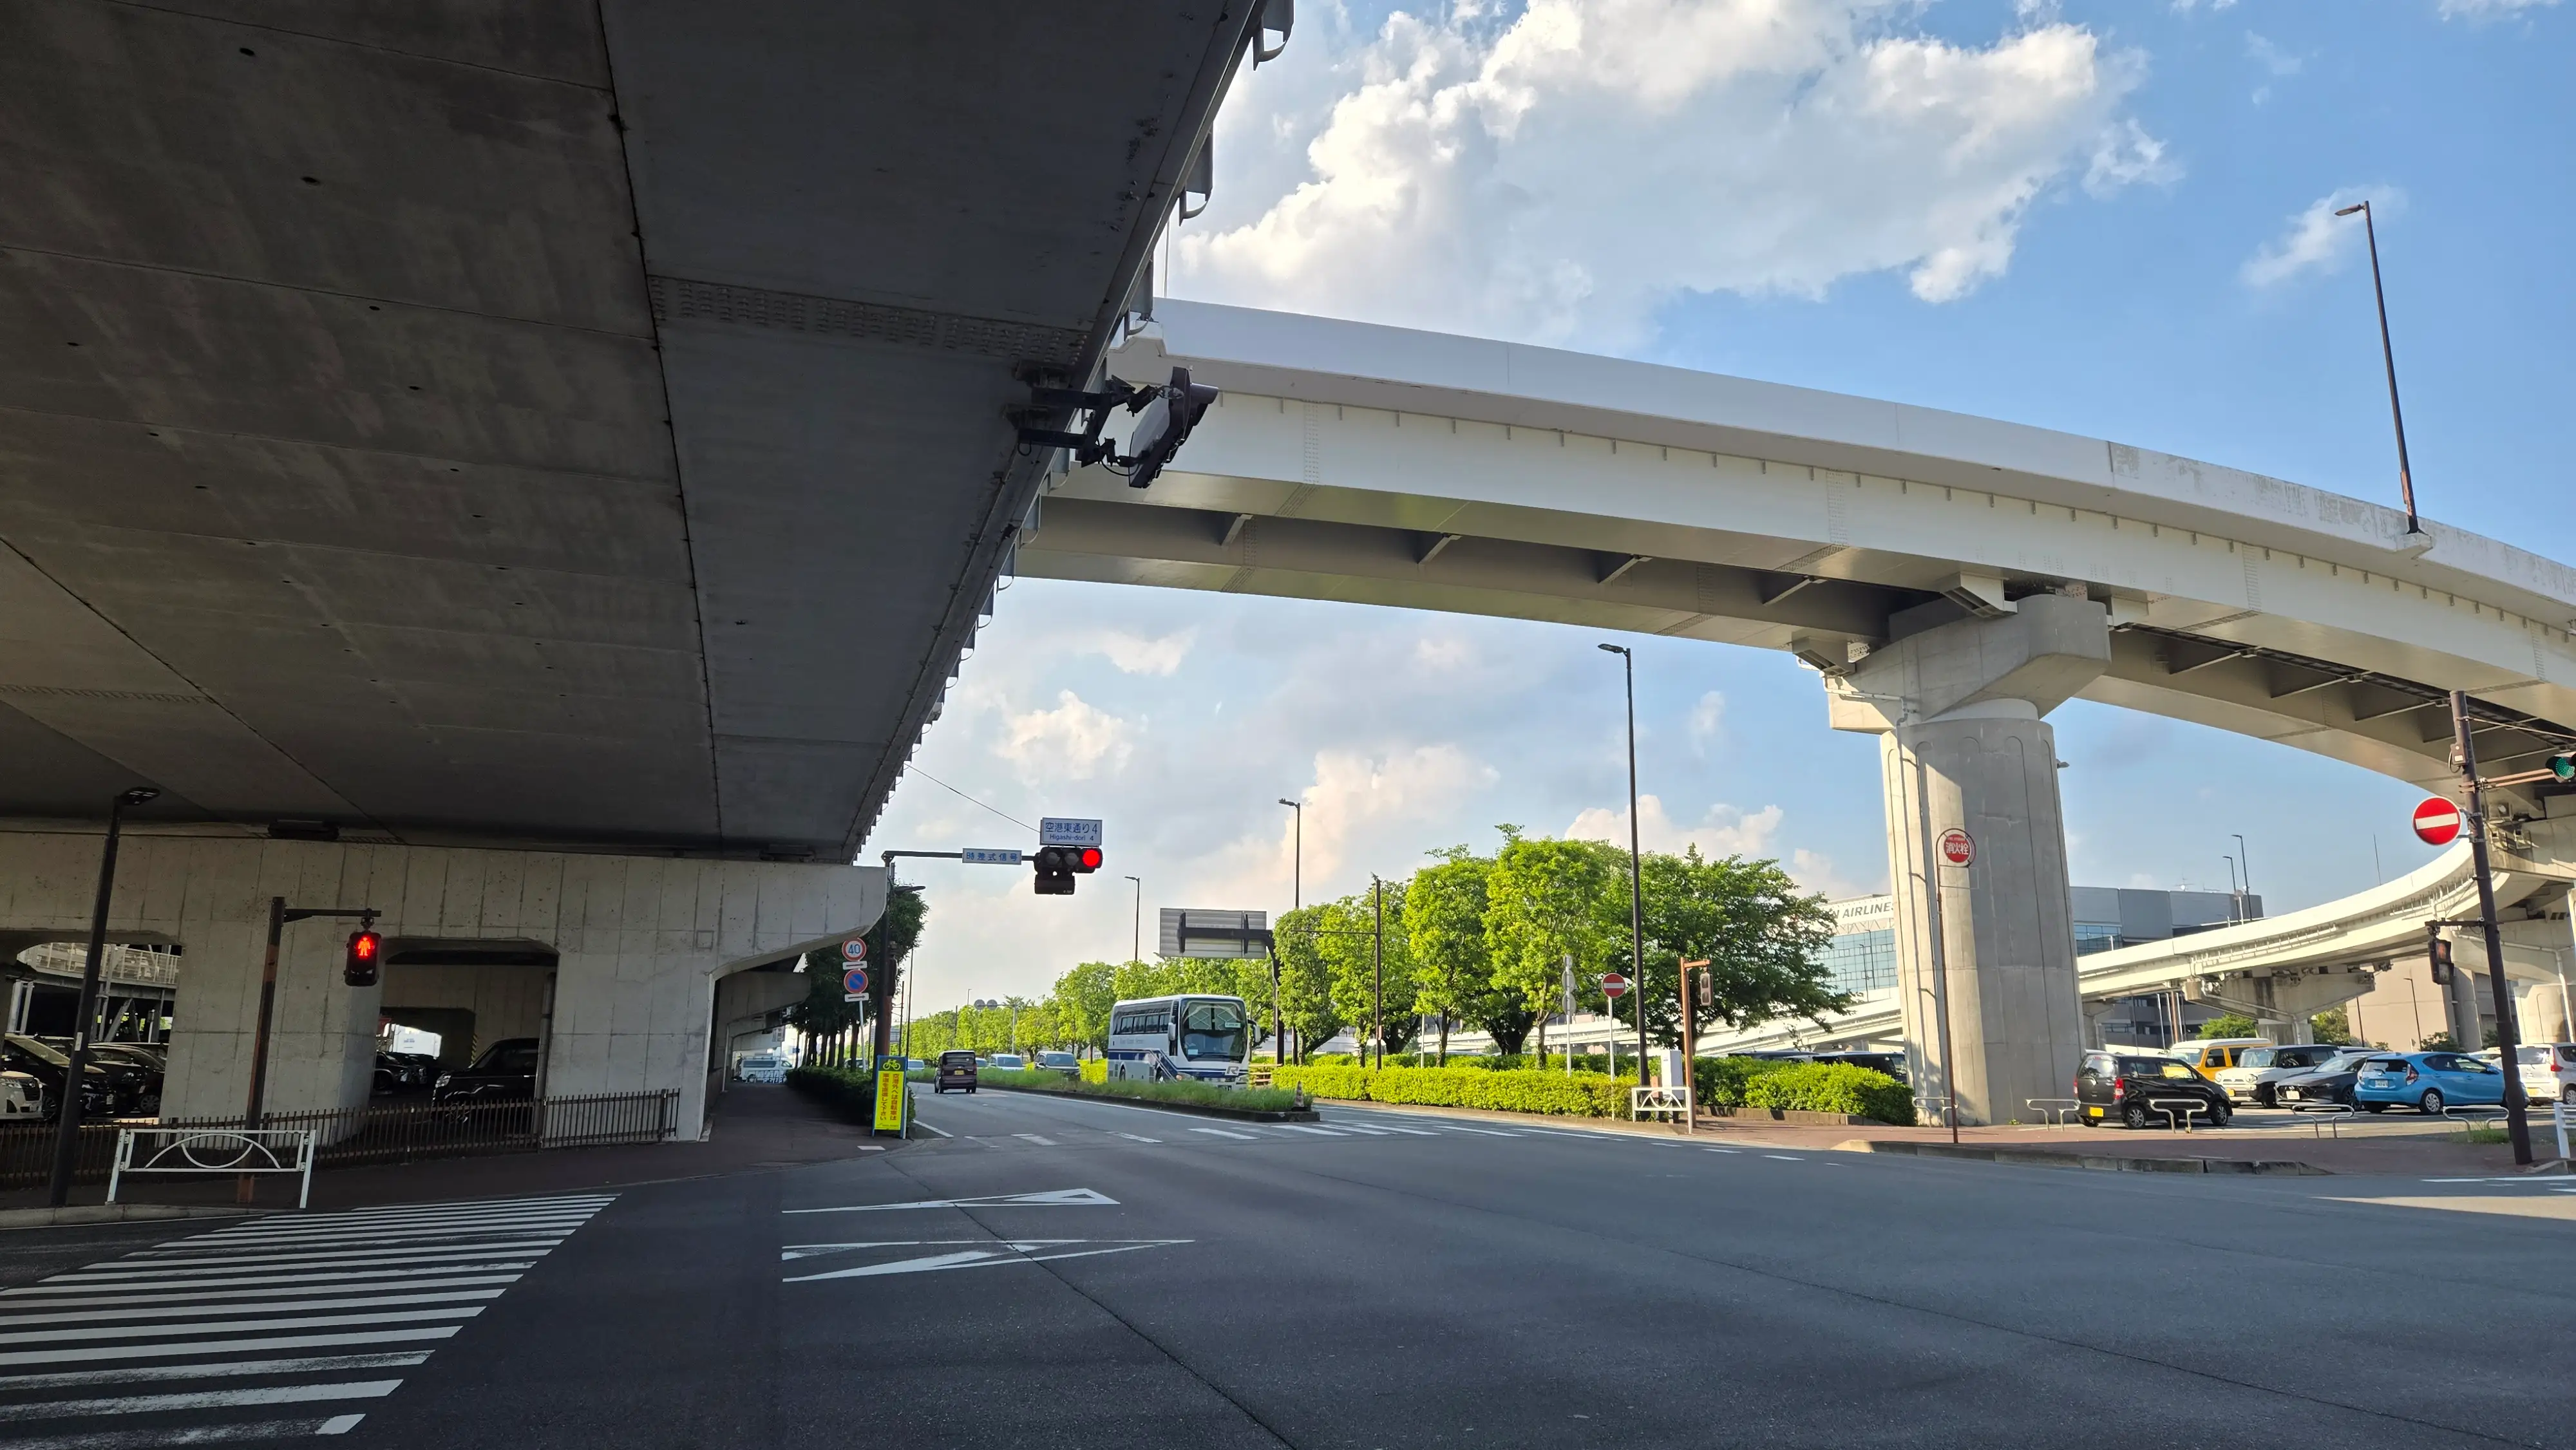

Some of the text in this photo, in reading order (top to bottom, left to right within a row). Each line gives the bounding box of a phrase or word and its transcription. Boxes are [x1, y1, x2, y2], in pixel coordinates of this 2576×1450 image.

[1946, 842, 1969, 854] 消火栓
[966, 852, 1018, 862] 時差式信号
[1842, 901, 1893, 919] AIRLINE
[848, 944, 861, 954] 40
